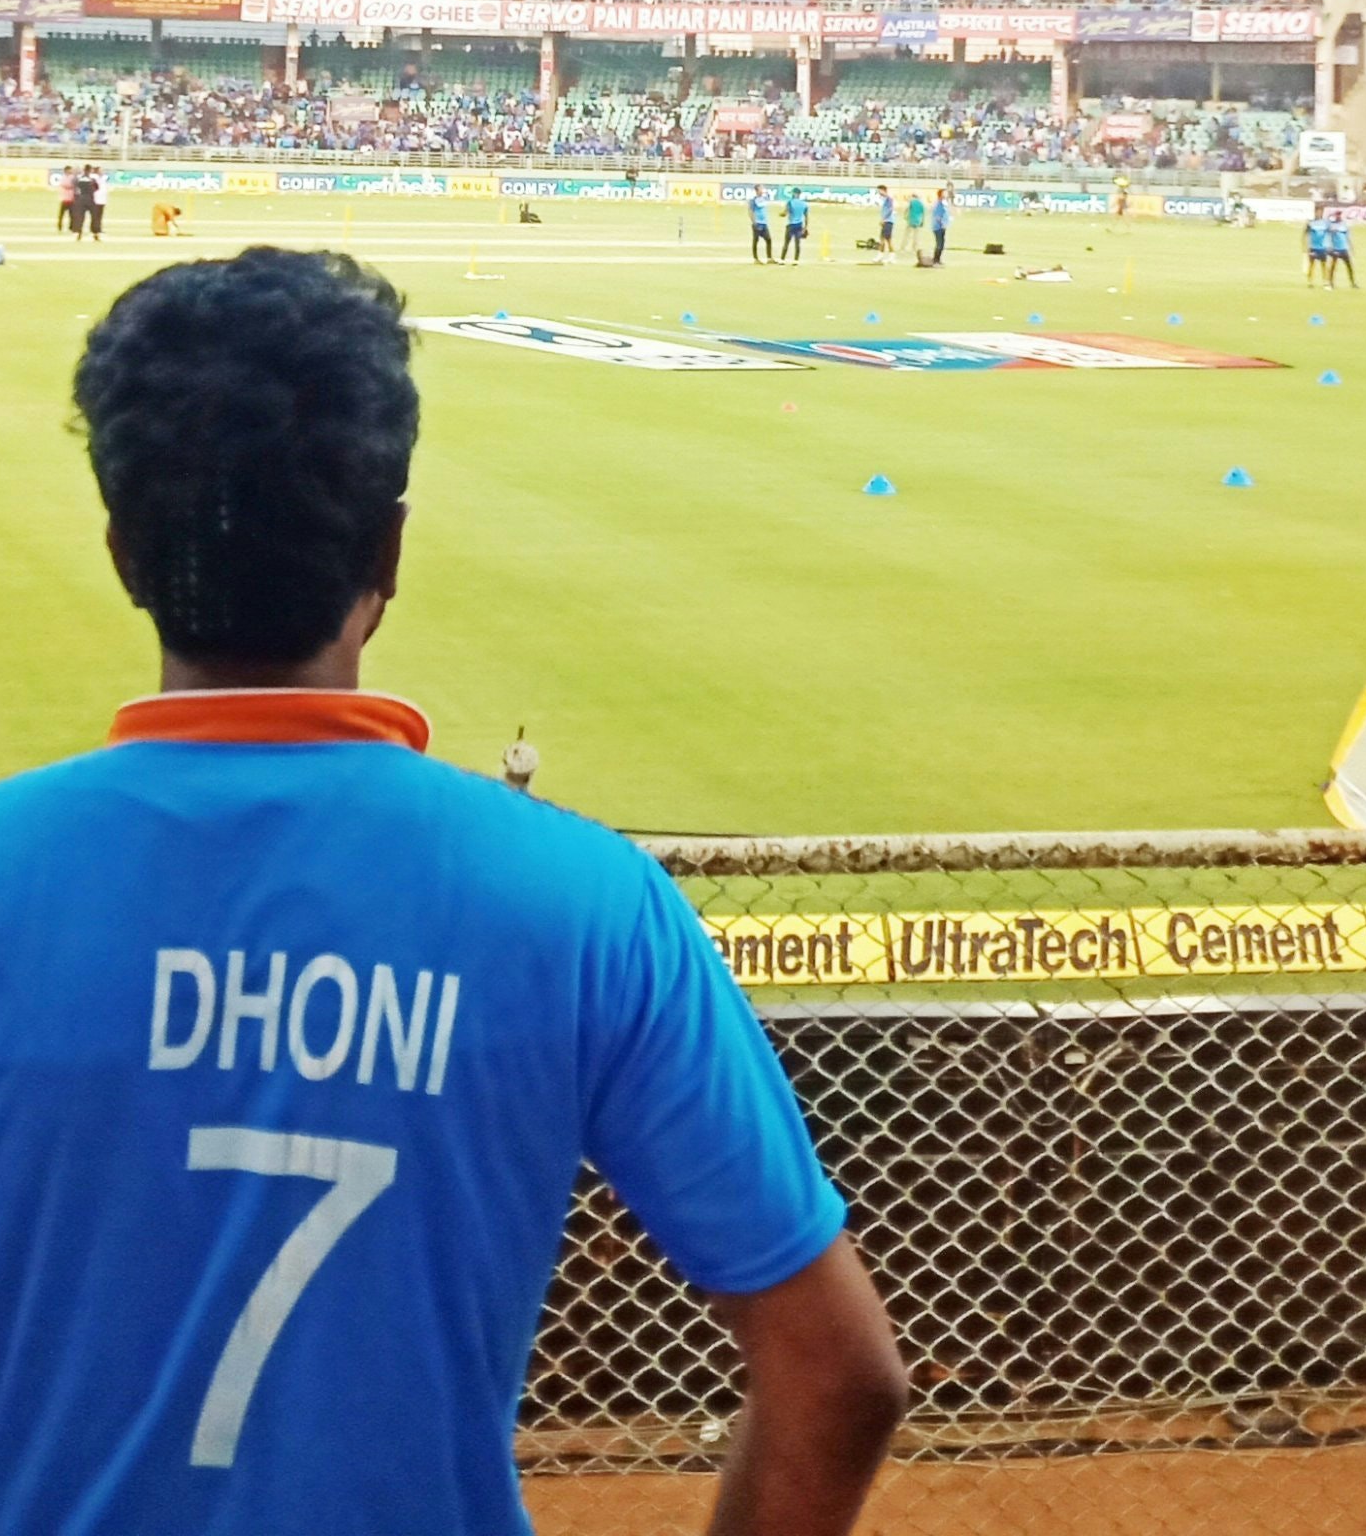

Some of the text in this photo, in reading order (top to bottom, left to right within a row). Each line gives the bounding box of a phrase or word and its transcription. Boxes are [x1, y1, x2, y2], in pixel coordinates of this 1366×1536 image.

[420, 5, 474, 23] GHEE
[505, 2, 588, 23] SERVO
[594, 6, 705, 31] PAN BAHAR
[709, 9, 820, 32] PAN BAHAR
[824, 16, 878, 33] SERVO
[896, 19, 938, 32] ASTRAL
[1223, 12, 1311, 34] SERVO
[133, 172, 220, 191] netmeds
[278, 176, 335, 191] COMFY
[451, 181, 492, 193] AMUL
[501, 181, 557, 196] COMFY
[672, 187, 714, 198] AMUL
[953, 193, 997, 207] OMFY
[1163, 199, 1222, 216] COMFY
[713, 921, 853, 977] ement
[900, 914, 1130, 975] UltraTech
[1166, 912, 1344, 966] Cement
[148, 948, 461, 1096] DHONI
[187, 1125, 398, 1470] 7
